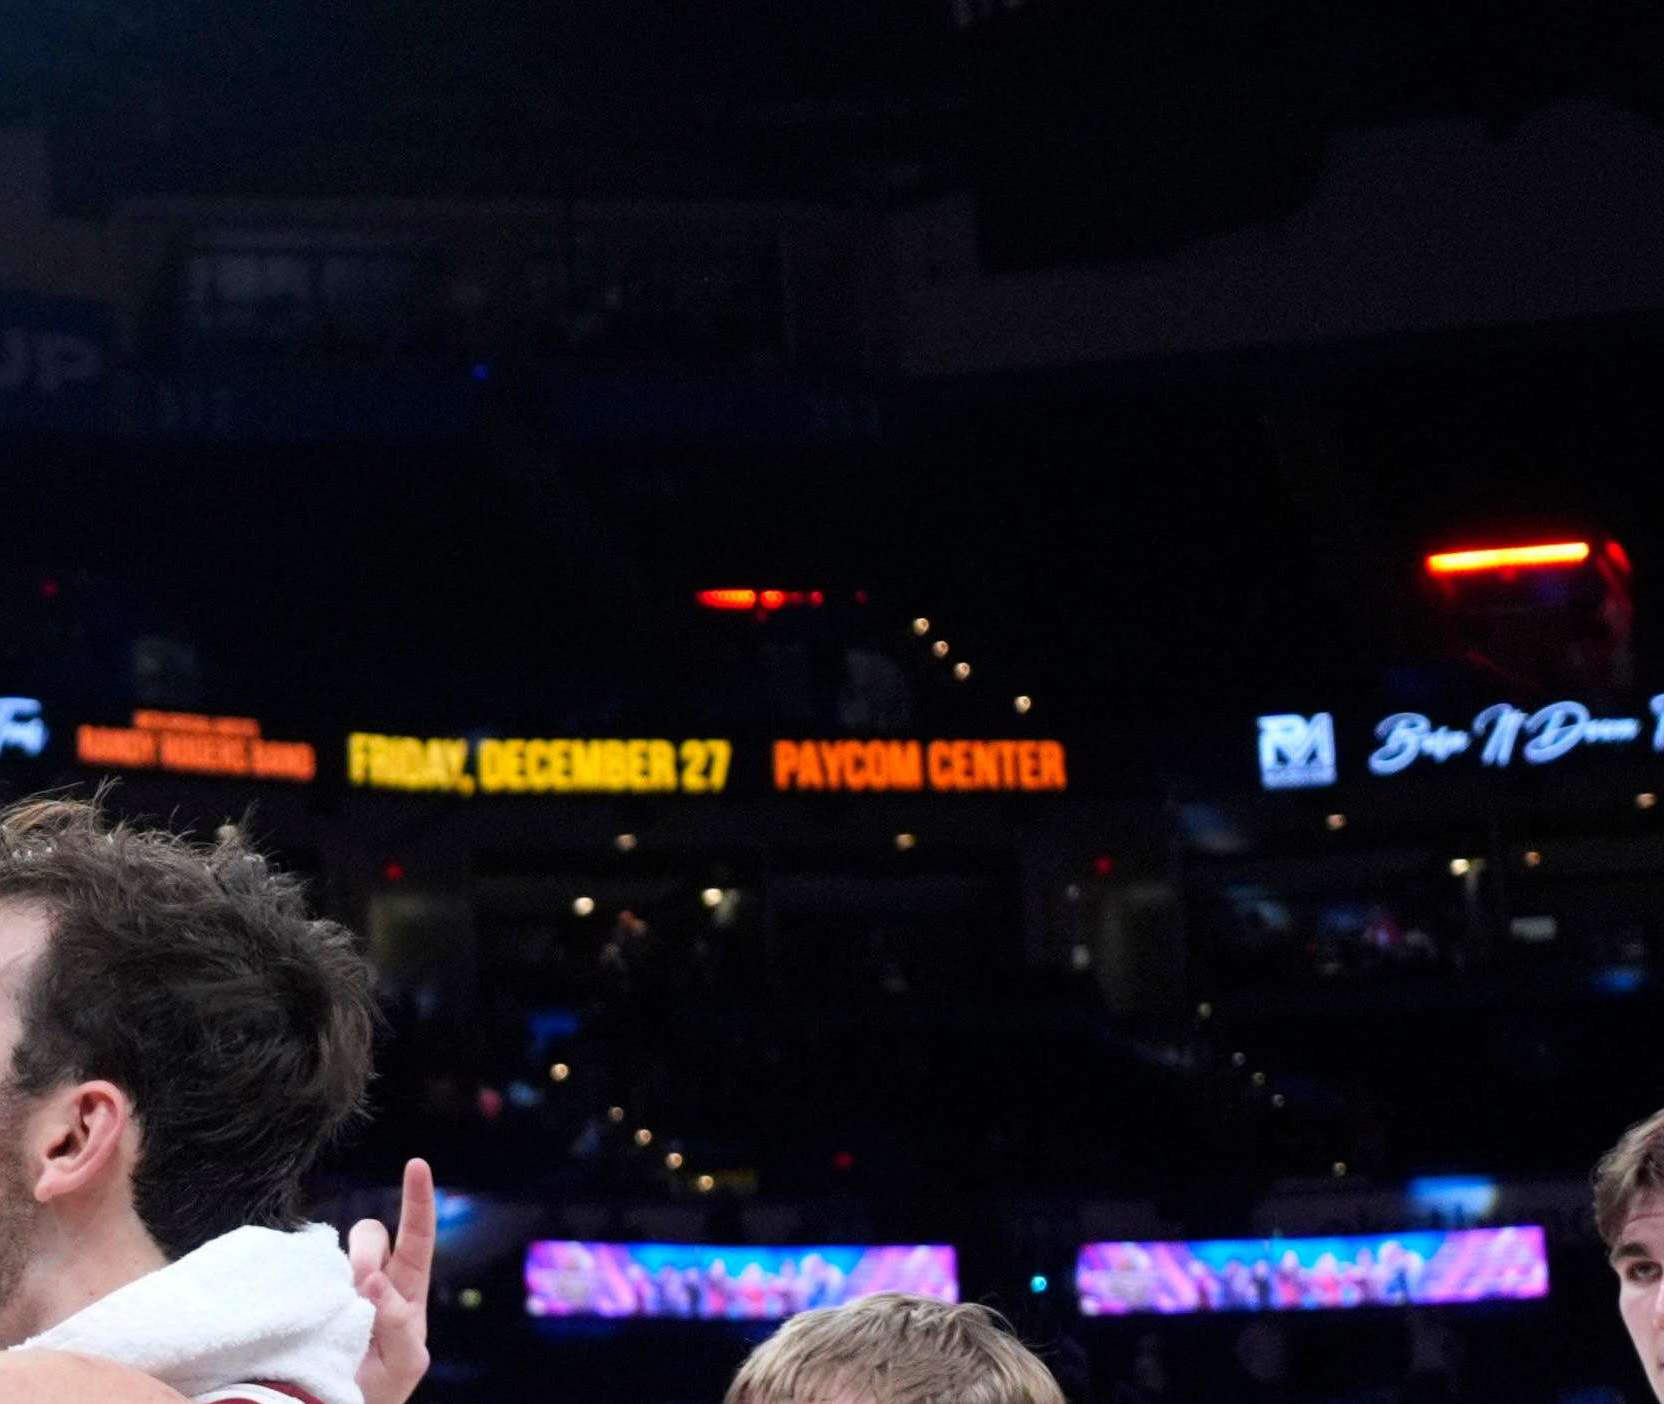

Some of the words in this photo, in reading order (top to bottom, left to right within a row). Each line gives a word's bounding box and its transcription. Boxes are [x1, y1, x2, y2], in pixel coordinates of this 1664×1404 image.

[478, 738, 677, 792] DECEMBER
[679, 740, 733, 793] 27
[773, 740, 923, 792] PAYCOM
[927, 740, 1067, 792] CENTER
